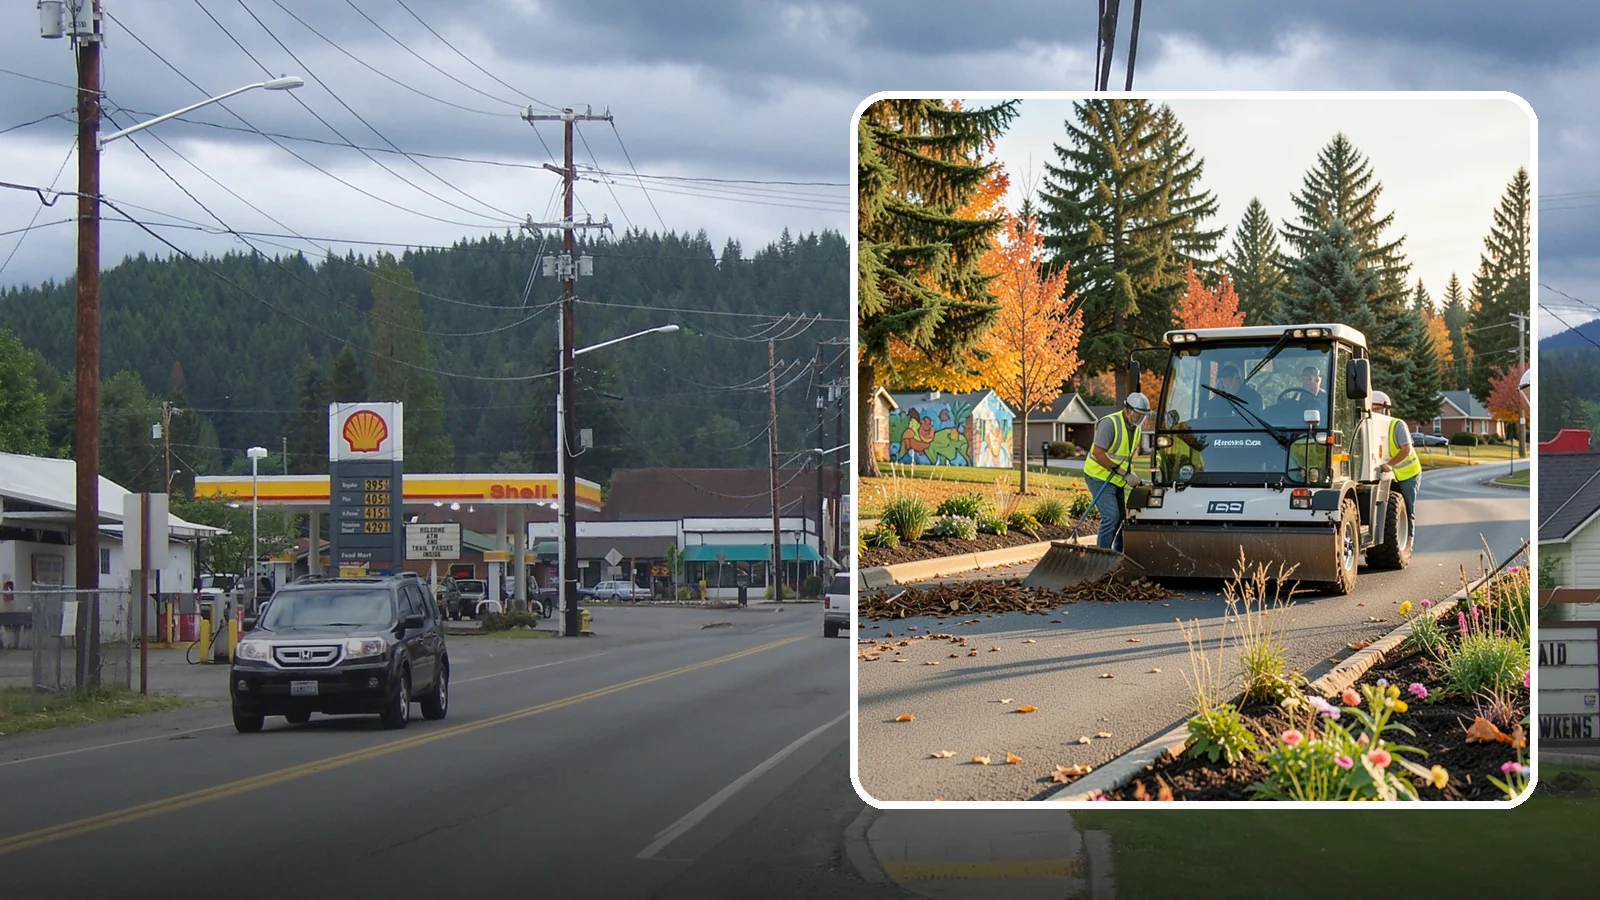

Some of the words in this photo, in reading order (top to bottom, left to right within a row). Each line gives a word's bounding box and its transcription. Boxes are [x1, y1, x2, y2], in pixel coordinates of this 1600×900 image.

[366, 480, 383, 490] 395
[490, 484, 547, 499] Shell
[366, 494, 383, 504] 405
[366, 508, 383, 518] 415
[366, 522, 383, 532] 429
